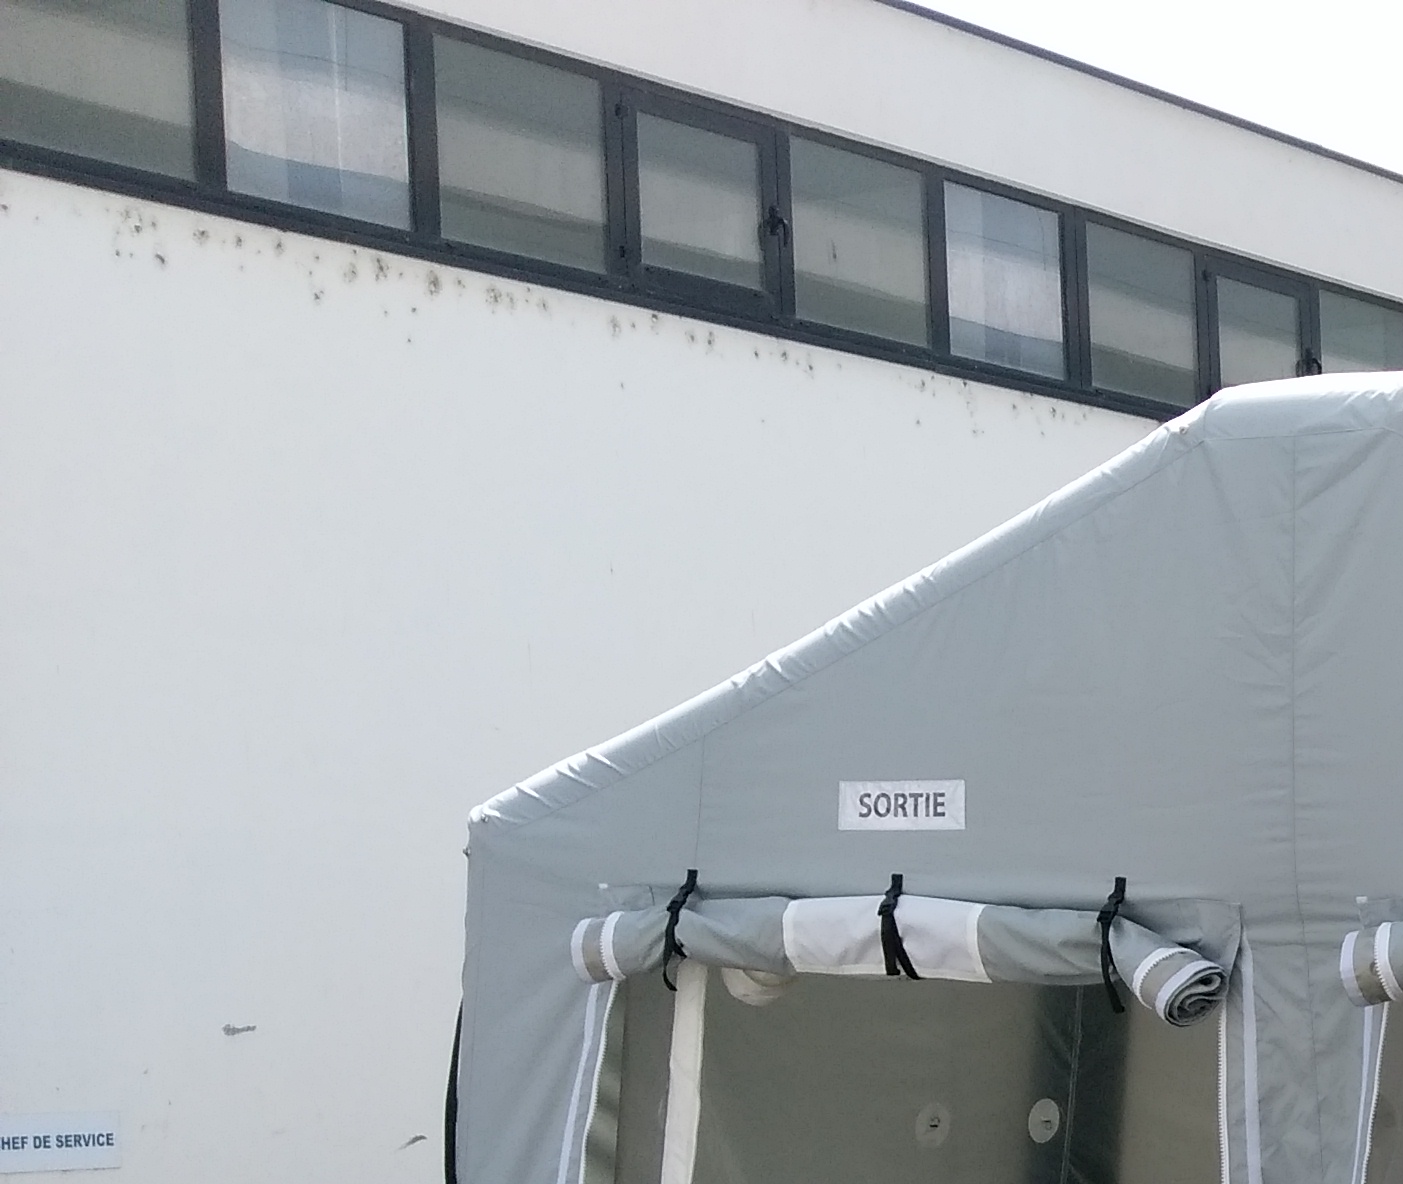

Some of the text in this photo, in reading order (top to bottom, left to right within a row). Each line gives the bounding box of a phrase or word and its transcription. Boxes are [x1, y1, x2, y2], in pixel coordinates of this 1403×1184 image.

[858, 792, 946, 818] SORTIE
[0, 1132, 115, 1150] HEF DE SERVICE
